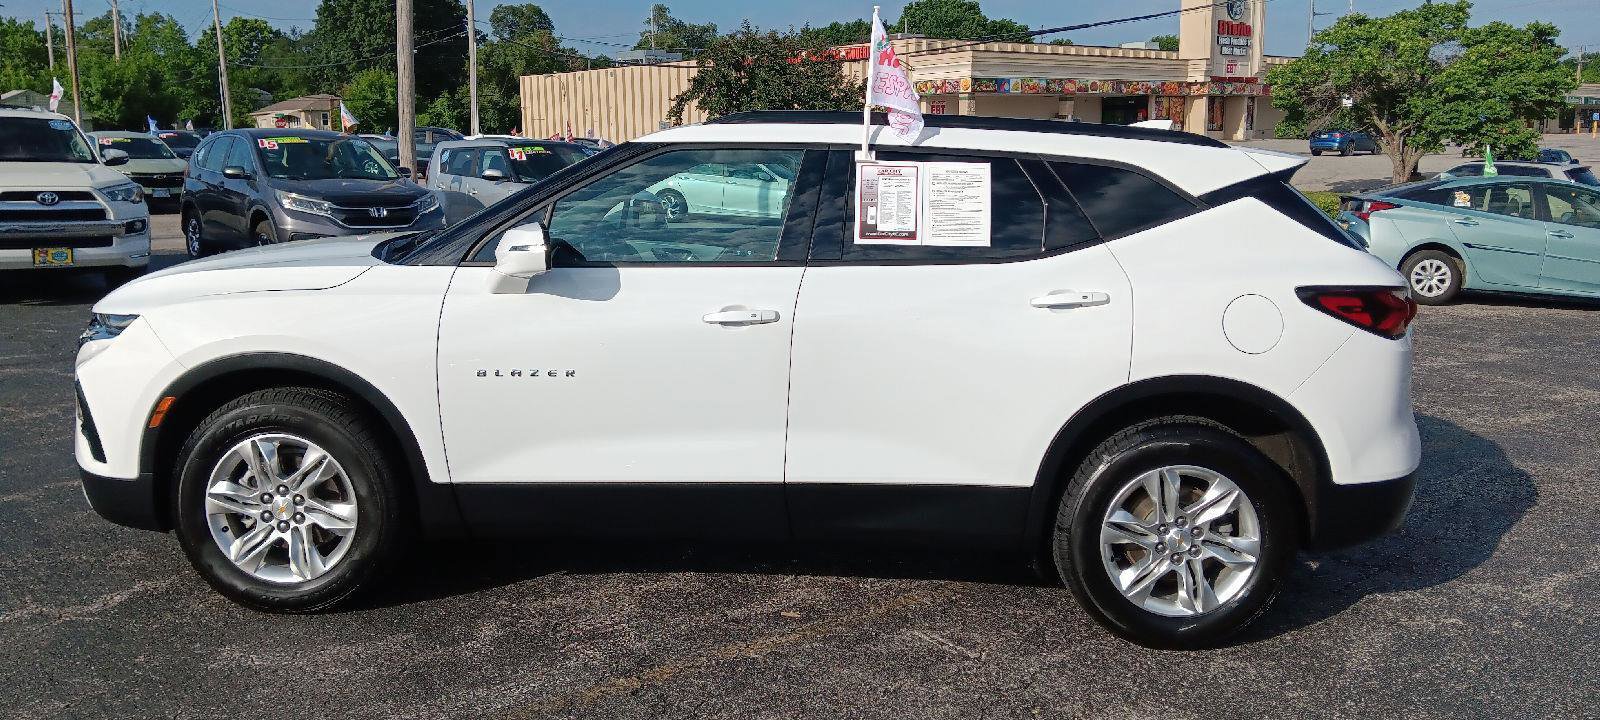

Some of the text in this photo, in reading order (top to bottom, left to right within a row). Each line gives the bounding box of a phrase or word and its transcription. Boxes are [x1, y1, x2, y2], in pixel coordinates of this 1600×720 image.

[1226, 64, 1237, 74] EBT
[930, 105, 946, 114] EBT
[476, 369, 576, 377] BLAZER
